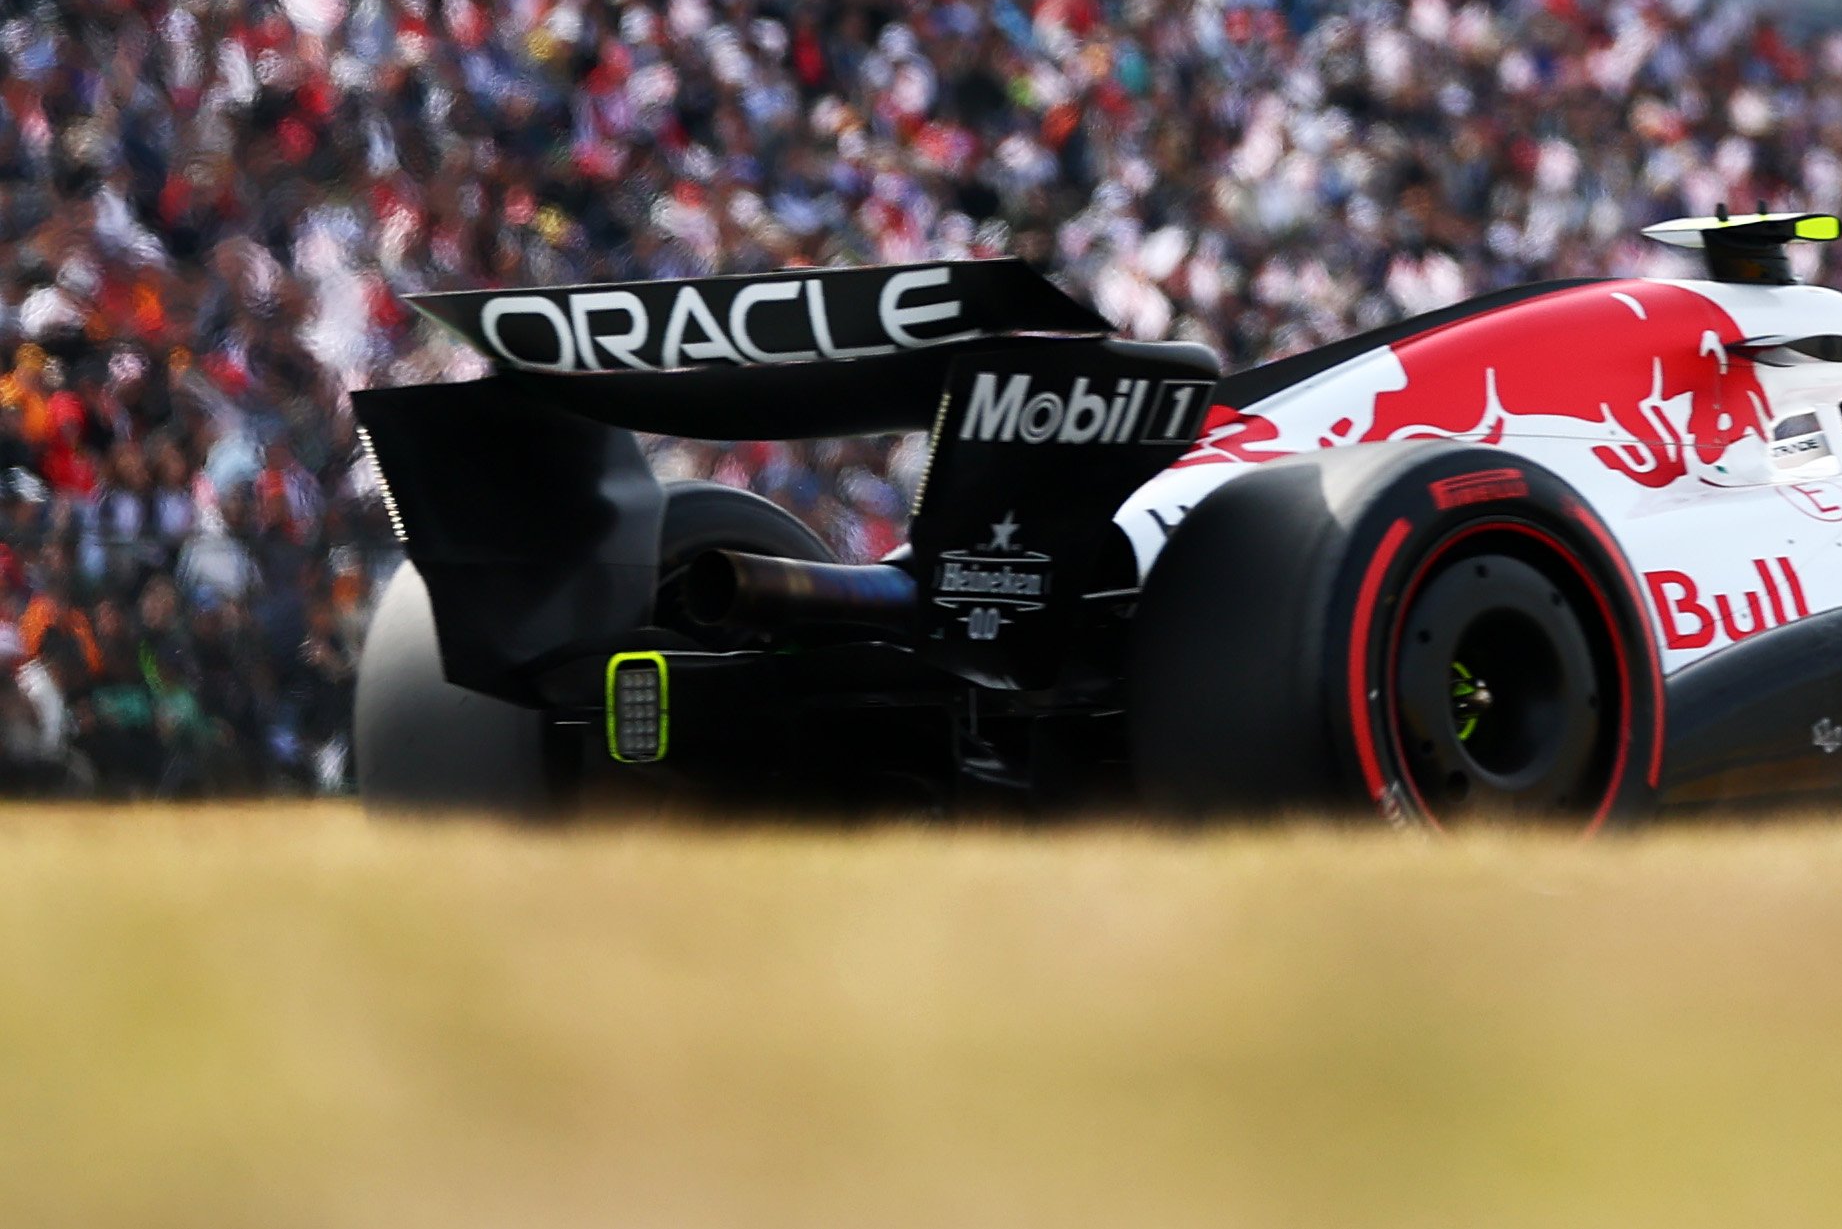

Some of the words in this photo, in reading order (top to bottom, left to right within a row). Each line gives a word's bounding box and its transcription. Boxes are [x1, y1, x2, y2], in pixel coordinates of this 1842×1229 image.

[480, 267, 981, 373] ORACLE
[960, 372, 1149, 443] Mobil
[1164, 387, 1195, 439] 1
[1643, 556, 1810, 650] Bull
